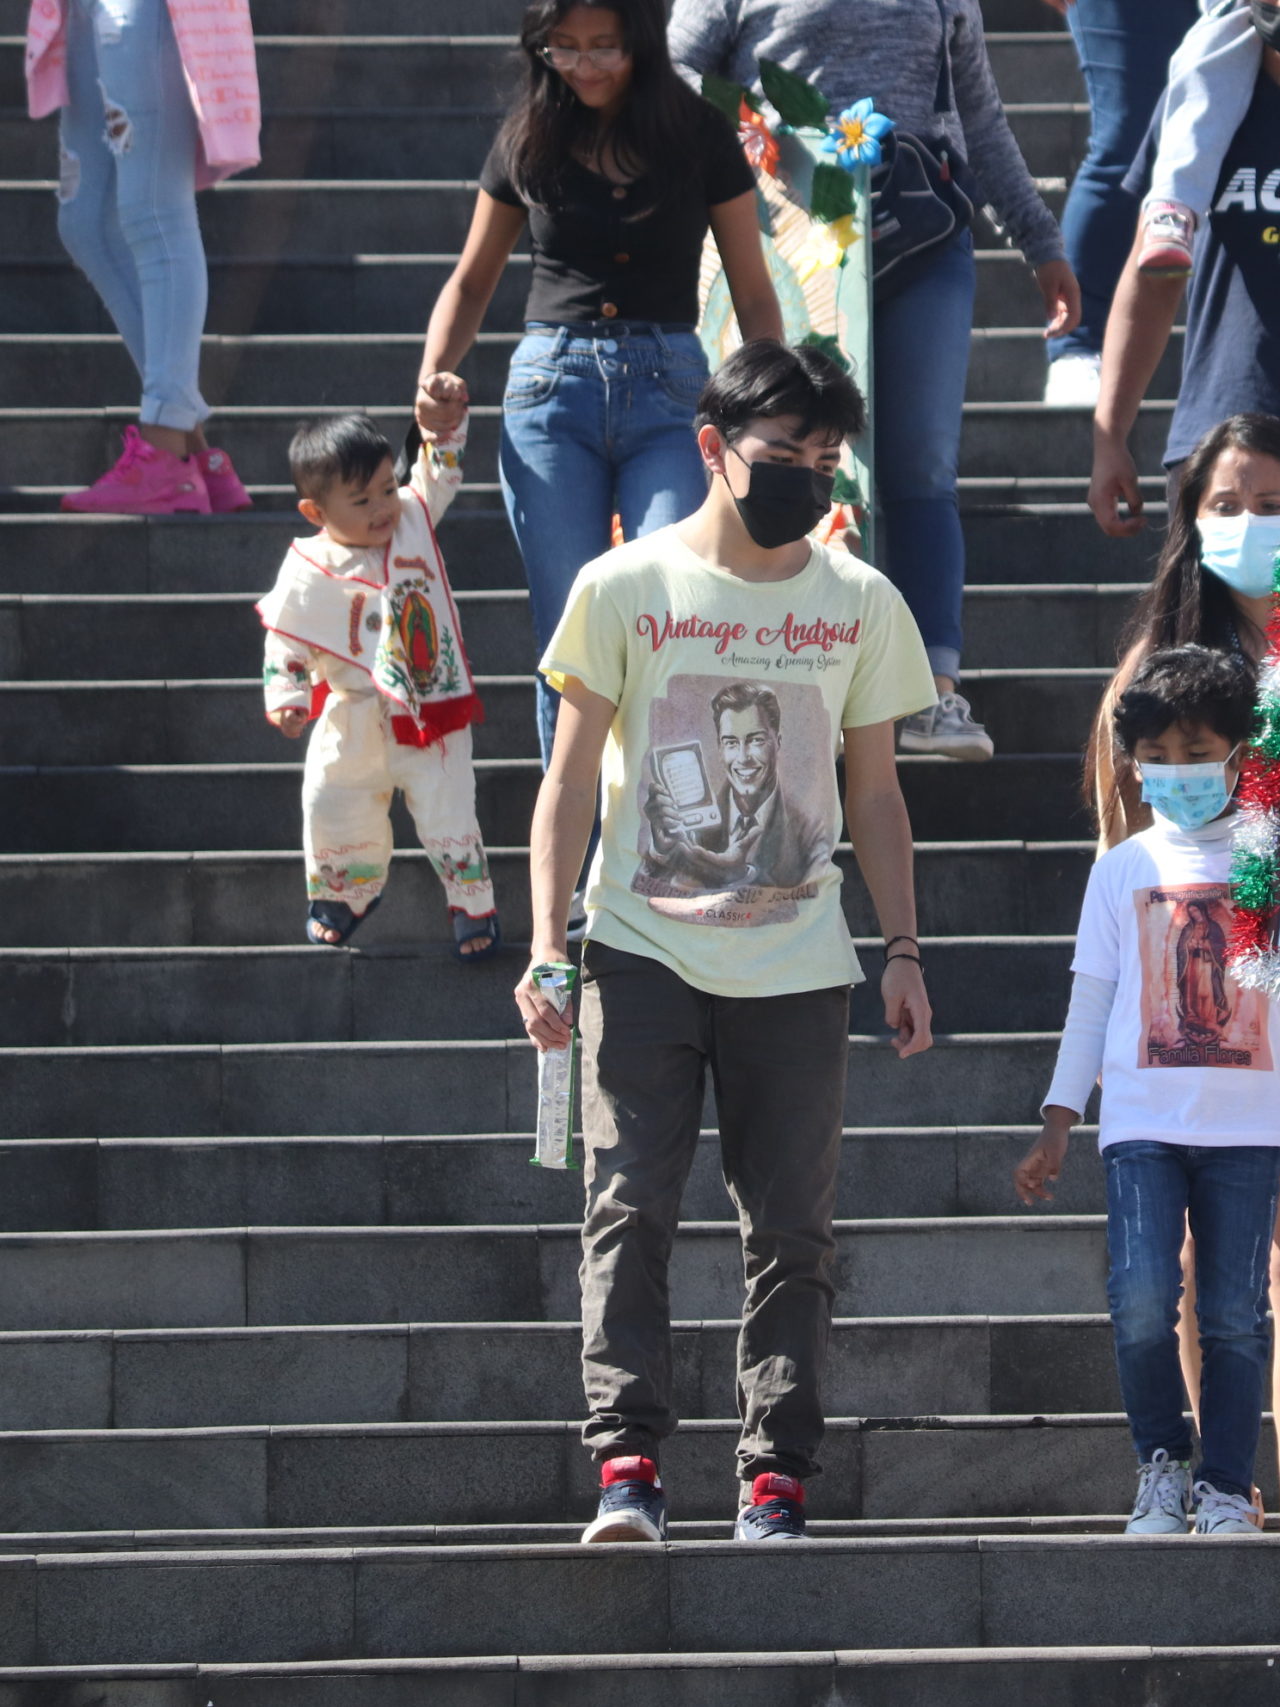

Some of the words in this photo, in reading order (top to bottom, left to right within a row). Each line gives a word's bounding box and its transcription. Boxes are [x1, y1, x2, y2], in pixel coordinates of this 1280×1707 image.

[636, 610, 748, 654] Vintage
[756, 612, 861, 654] Android
[721, 652, 771, 671] Amazing
[1148, 1045, 1200, 1065] Familia
[1205, 1045, 1252, 1066] Flores
